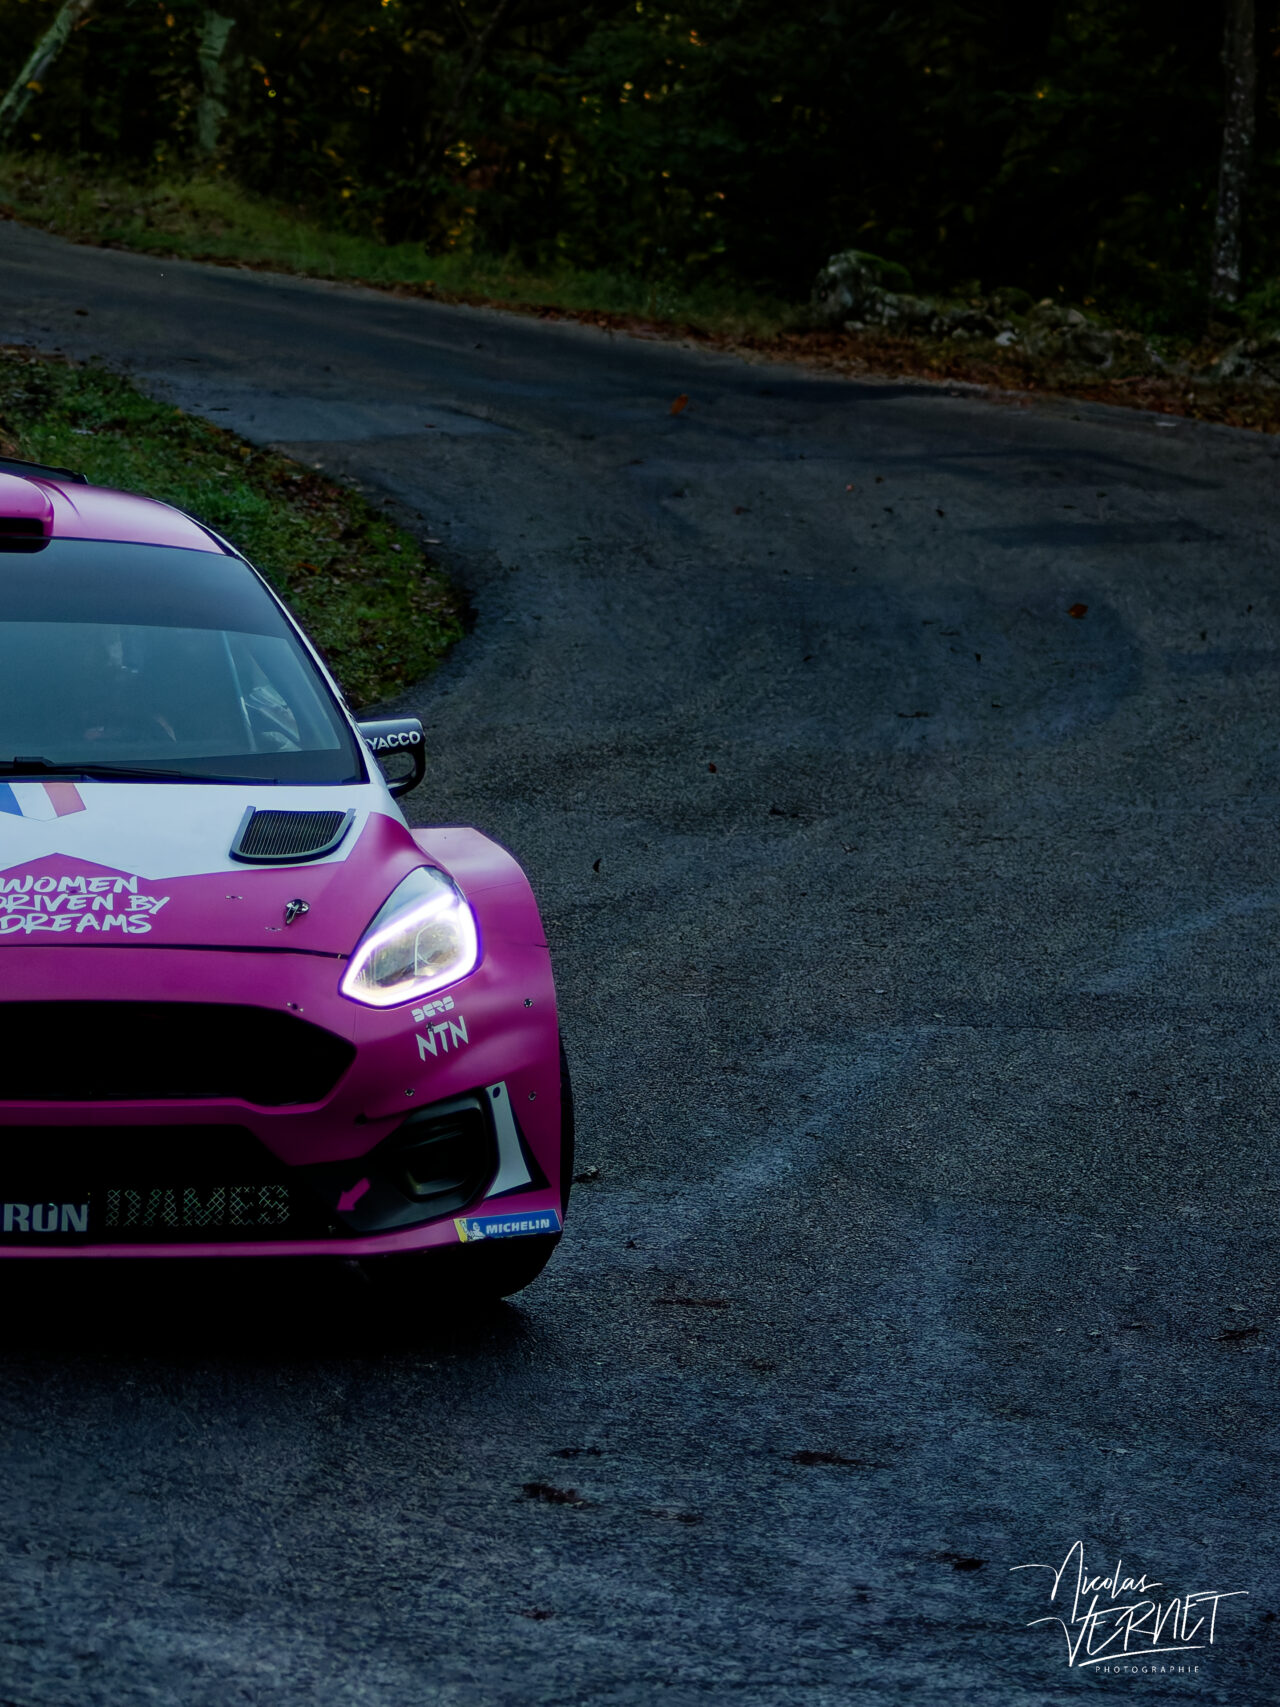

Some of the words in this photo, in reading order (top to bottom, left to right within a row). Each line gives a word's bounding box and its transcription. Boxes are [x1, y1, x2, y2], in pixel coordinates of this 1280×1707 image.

[365, 730, 421, 751] YACCO
[124, 895, 170, 914] BY
[415, 1015, 469, 1062] NTN
[105, 1185, 290, 1228] DAMES
[485, 1218, 551, 1234] MICHELIN
